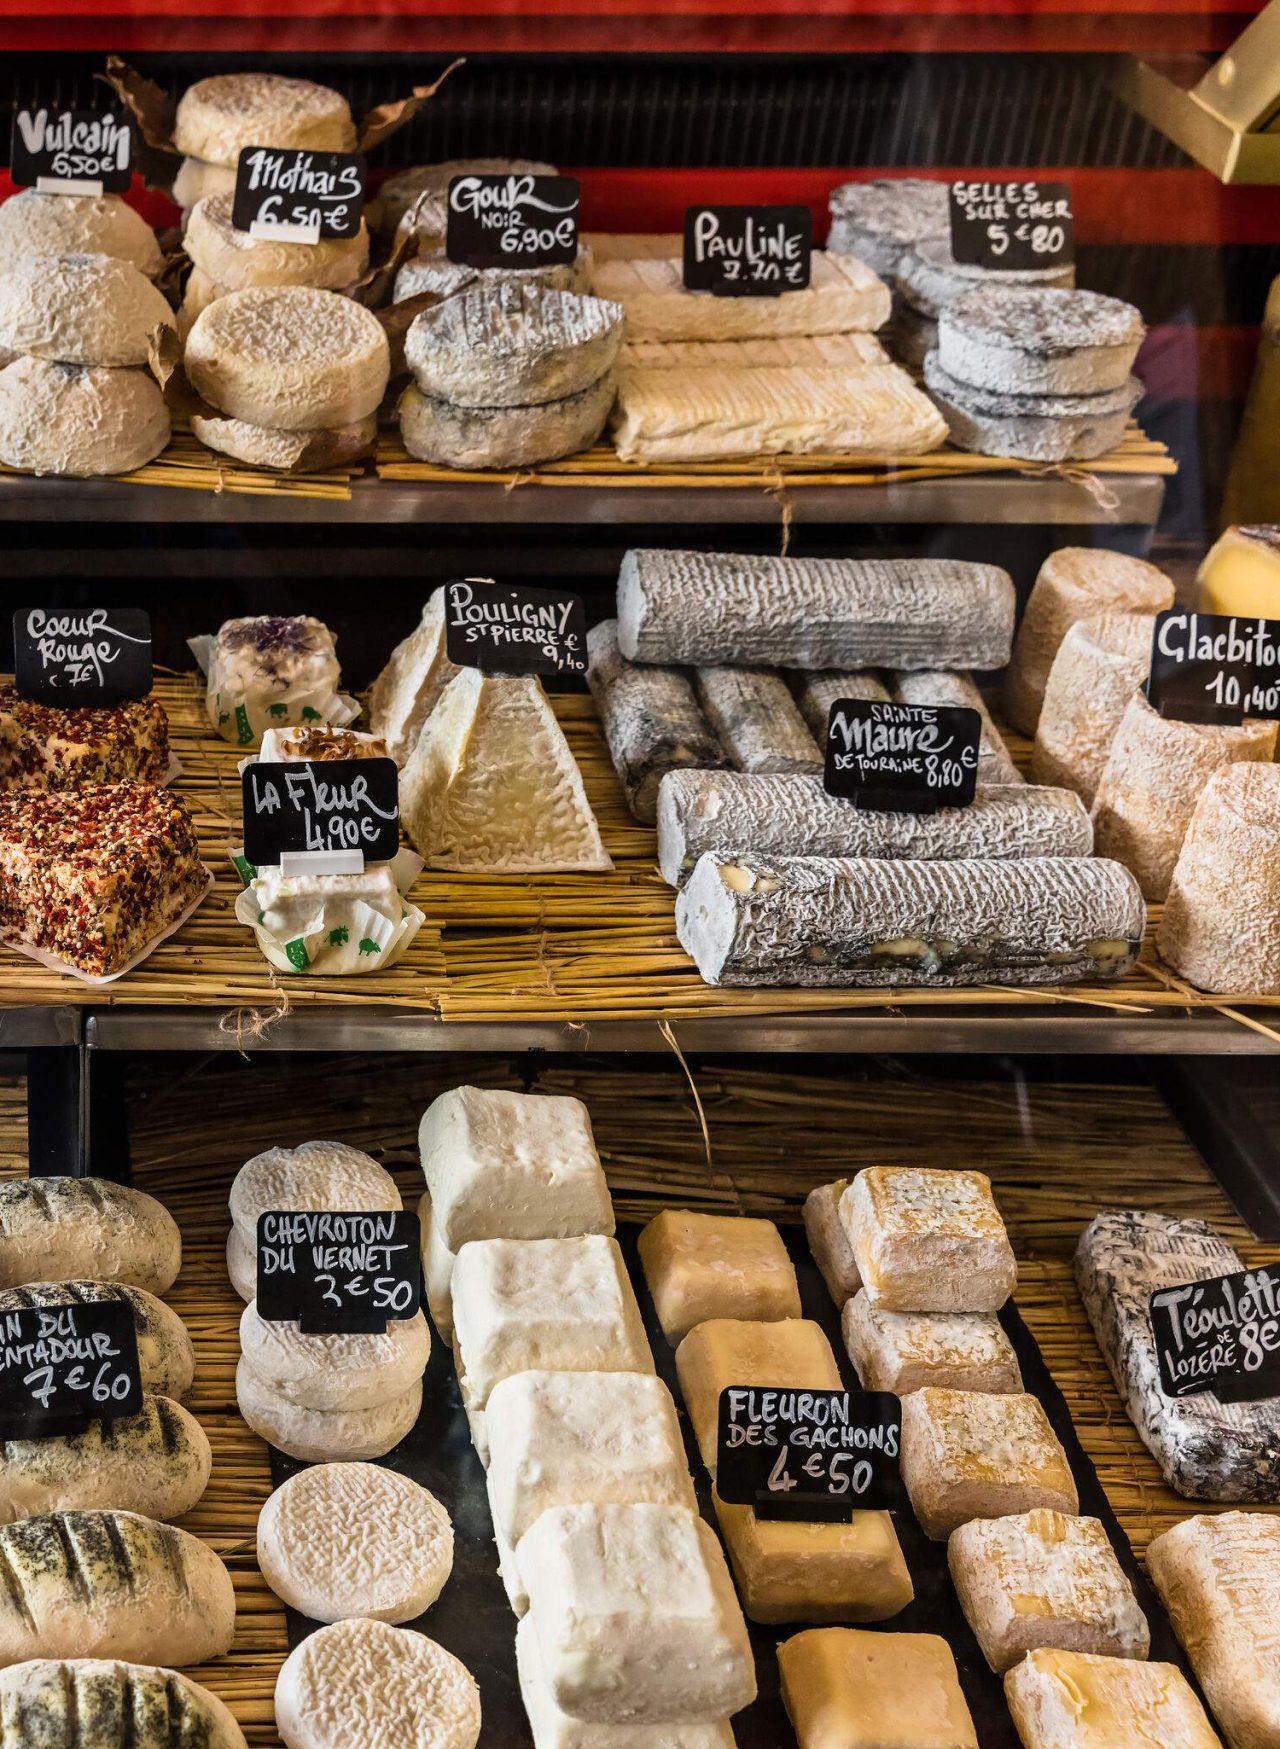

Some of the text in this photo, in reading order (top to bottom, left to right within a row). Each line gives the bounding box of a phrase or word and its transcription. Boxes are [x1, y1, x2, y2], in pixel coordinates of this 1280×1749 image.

[17, 109, 130, 170] Vulcain
[952, 181, 1039, 205] SELLES
[965, 200, 1072, 221] SUR CHER
[500, 218, 575, 252] 6,90€
[1158, 613, 1280, 666] Clacbito
[37, 638, 120, 687] Rouge
[830, 711, 954, 757] Maure
[834, 753, 853, 769] DE
[925, 745, 977, 788] 8,80€
[253, 774, 280, 814] LA
[305, 806, 380, 850] 4,90€
[264, 1213, 395, 1244] CHEVROTON
[261, 1244, 408, 1274] DU VERNET
[37, 1308, 77, 1338] DU
[1216, 1329, 1234, 1344] DE
[727, 1389, 849, 1426] FLEURON
[726, 1423, 899, 1457] DES GACHONS
